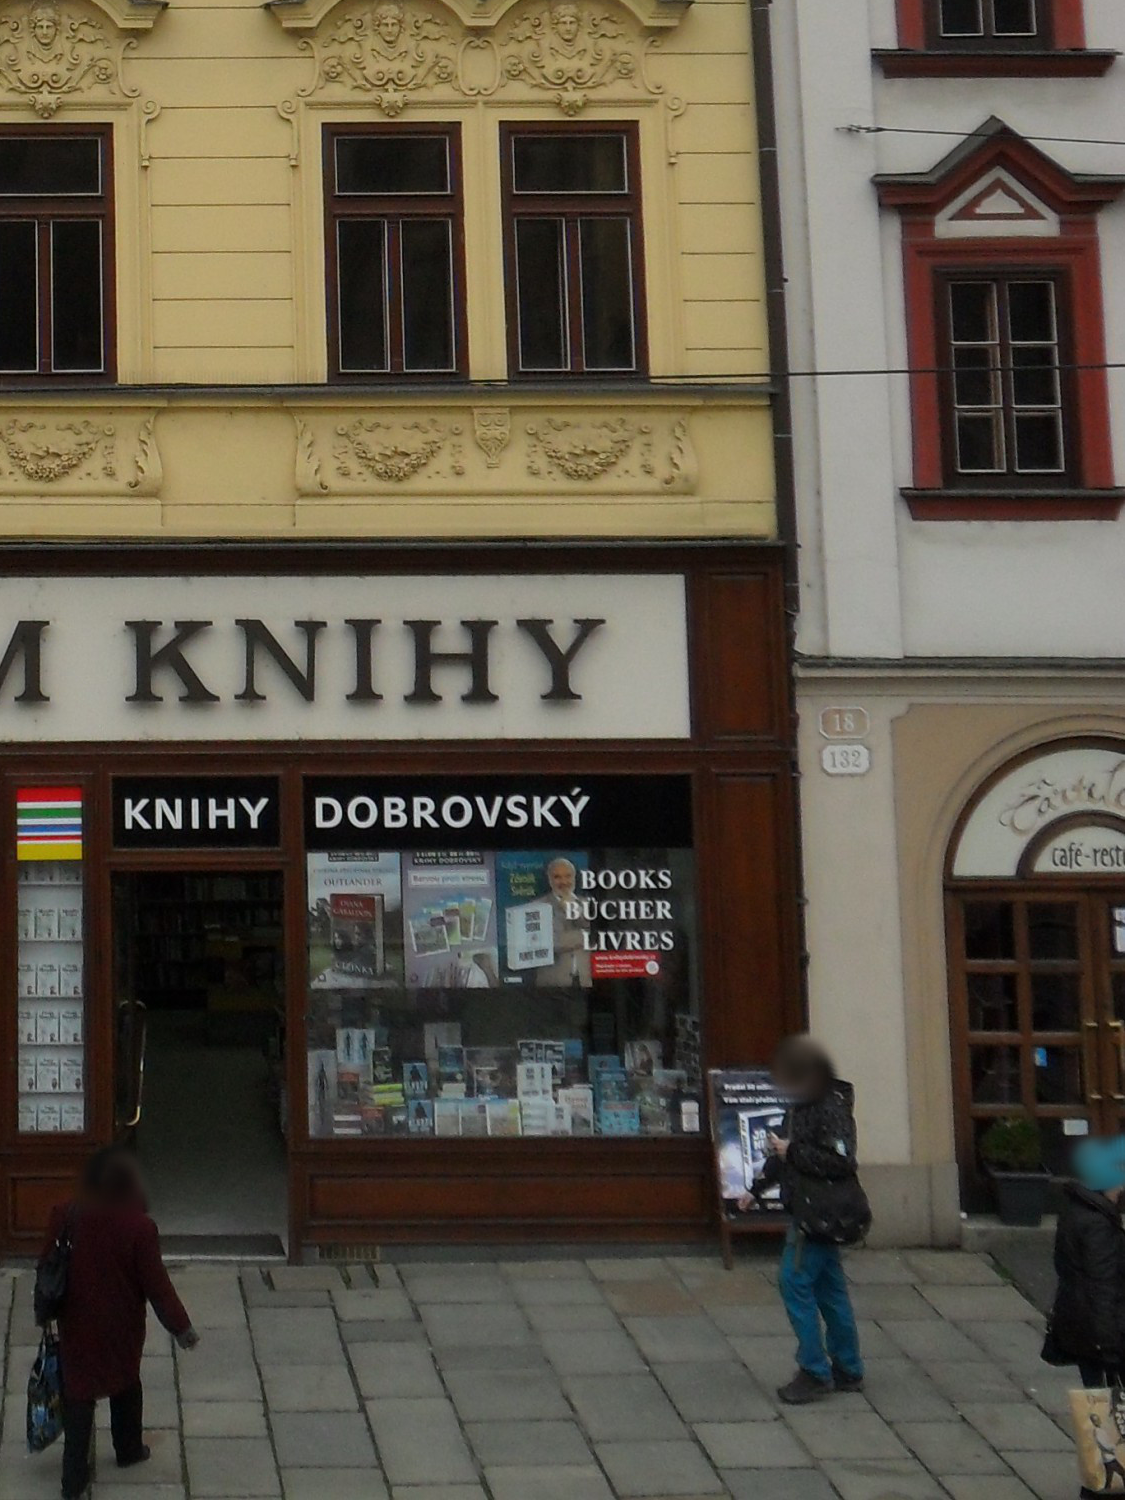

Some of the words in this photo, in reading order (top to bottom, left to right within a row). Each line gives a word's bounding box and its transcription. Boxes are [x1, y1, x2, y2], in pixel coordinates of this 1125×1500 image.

[125, 618, 605, 704] KNIHY
[835, 713, 854, 732] 18
[830, 749, 861, 769] 132
[124, 797, 270, 830] KNIHY
[314, 788, 590, 829] DOBROVSKÝ
[1052, 842, 1125, 869] café-rest
[324, 878, 383, 887] OUTLANDER
[580, 869, 673, 890] BOOKS
[565, 897, 673, 920] BÜCHER
[581, 929, 675, 951] LIVRES
